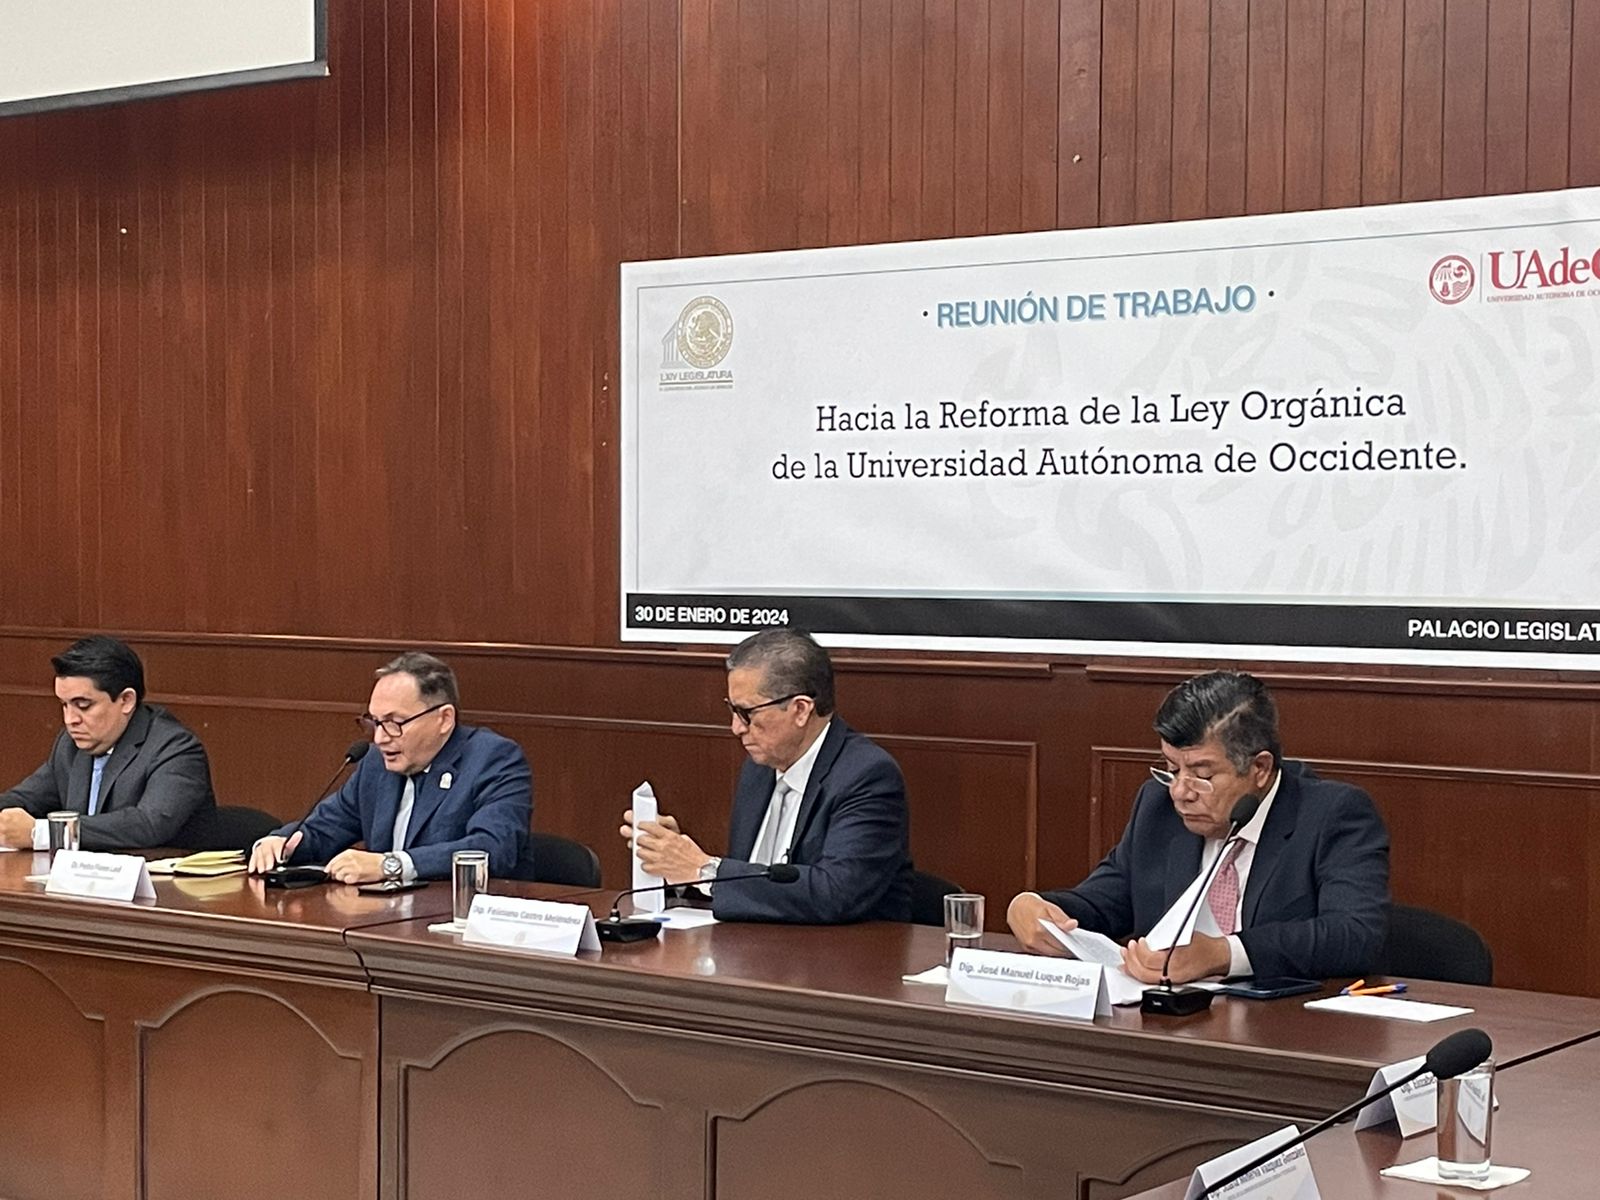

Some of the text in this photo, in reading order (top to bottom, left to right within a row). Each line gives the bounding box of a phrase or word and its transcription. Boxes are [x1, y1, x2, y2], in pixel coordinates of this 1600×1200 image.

[1576, 289, 1586, 297] DE
[937, 285, 1257, 328] REUNIÓN DE TRABAJO
[660, 370, 733, 381] LXIV LEGISLATURA
[816, 387, 1406, 432] Hacia la Reforma de la Ley Orgánica
[772, 441, 1467, 480] de la Universidad Autónoma de Occidente.
[635, 606, 789, 625] 30 DE ENERO DE 2024
[1408, 619, 1500, 640] PALACIO
[958, 962, 975, 974] Dip.
[977, 964, 999, 976] José
[1000, 967, 1034, 980] Manuel
[1035, 970, 1063, 983] Luque
[1064, 974, 1091, 987] Rojas
